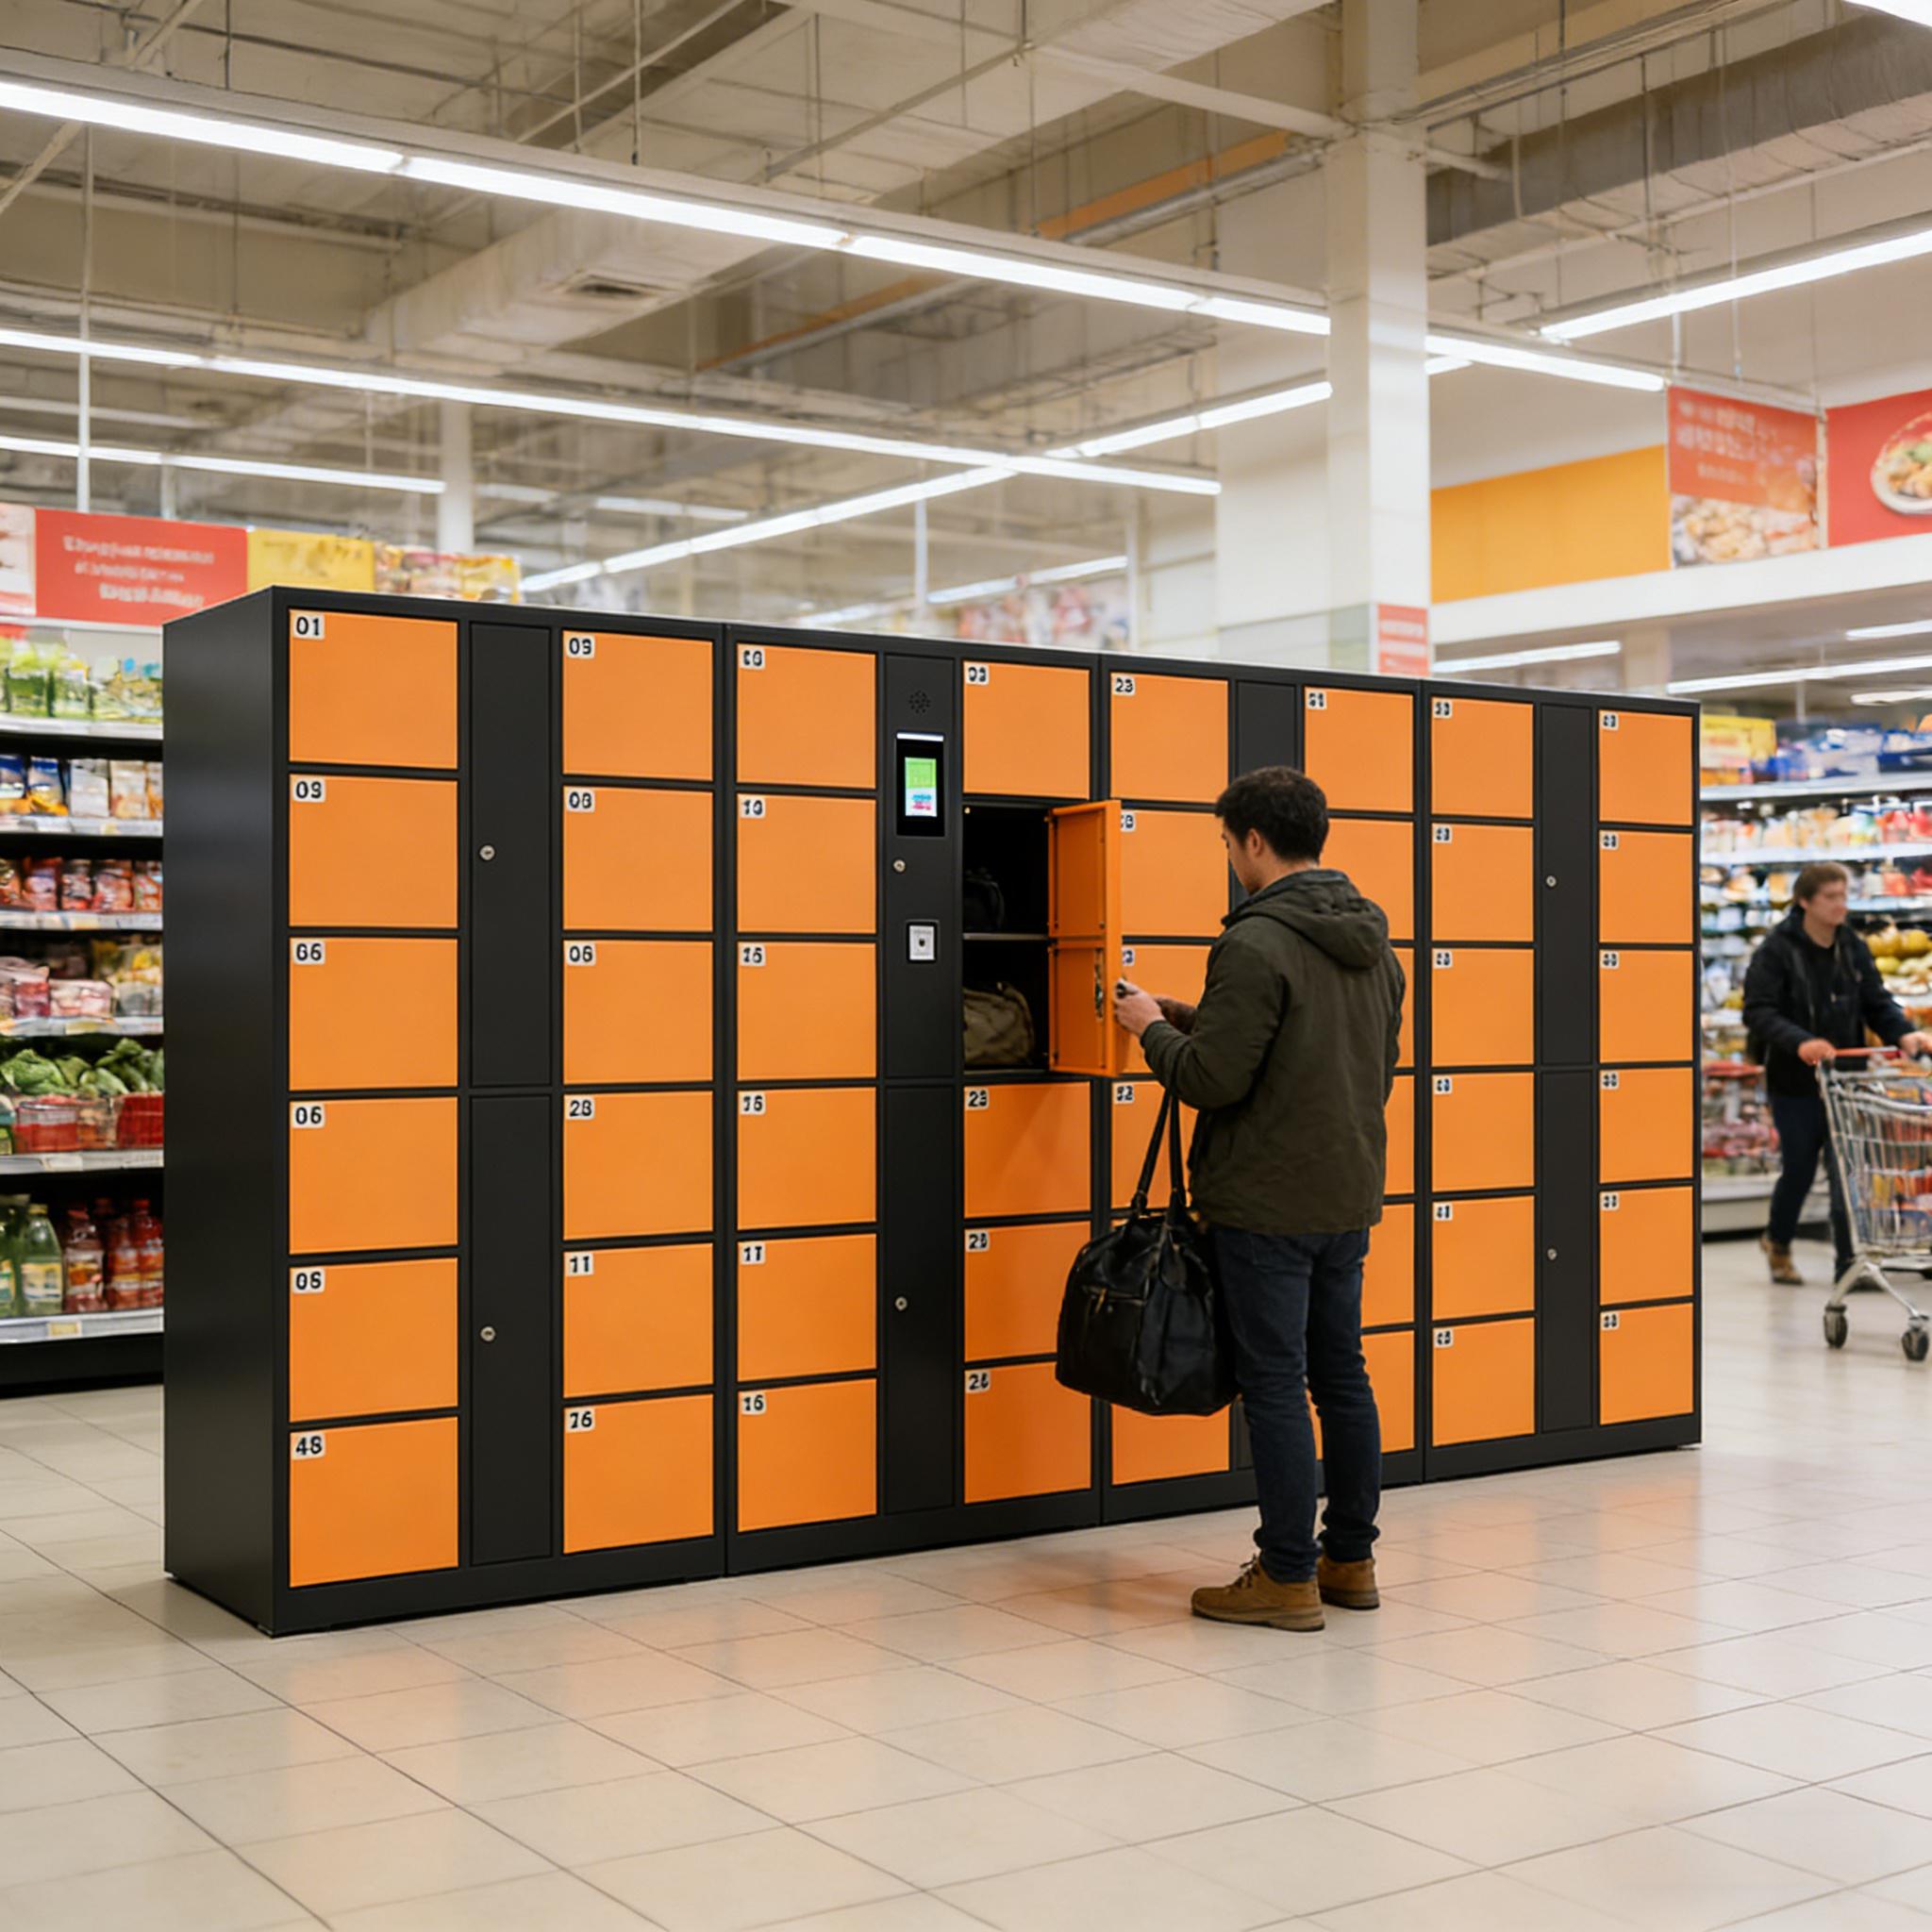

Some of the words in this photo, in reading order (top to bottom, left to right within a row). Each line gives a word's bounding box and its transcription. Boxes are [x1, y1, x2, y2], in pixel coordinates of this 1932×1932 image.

[296, 616, 320, 636] 01
[296, 781, 322, 799] 09
[570, 945, 592, 962] 06
[296, 1107, 322, 1124] 06
[570, 1256, 590, 1273] 11
